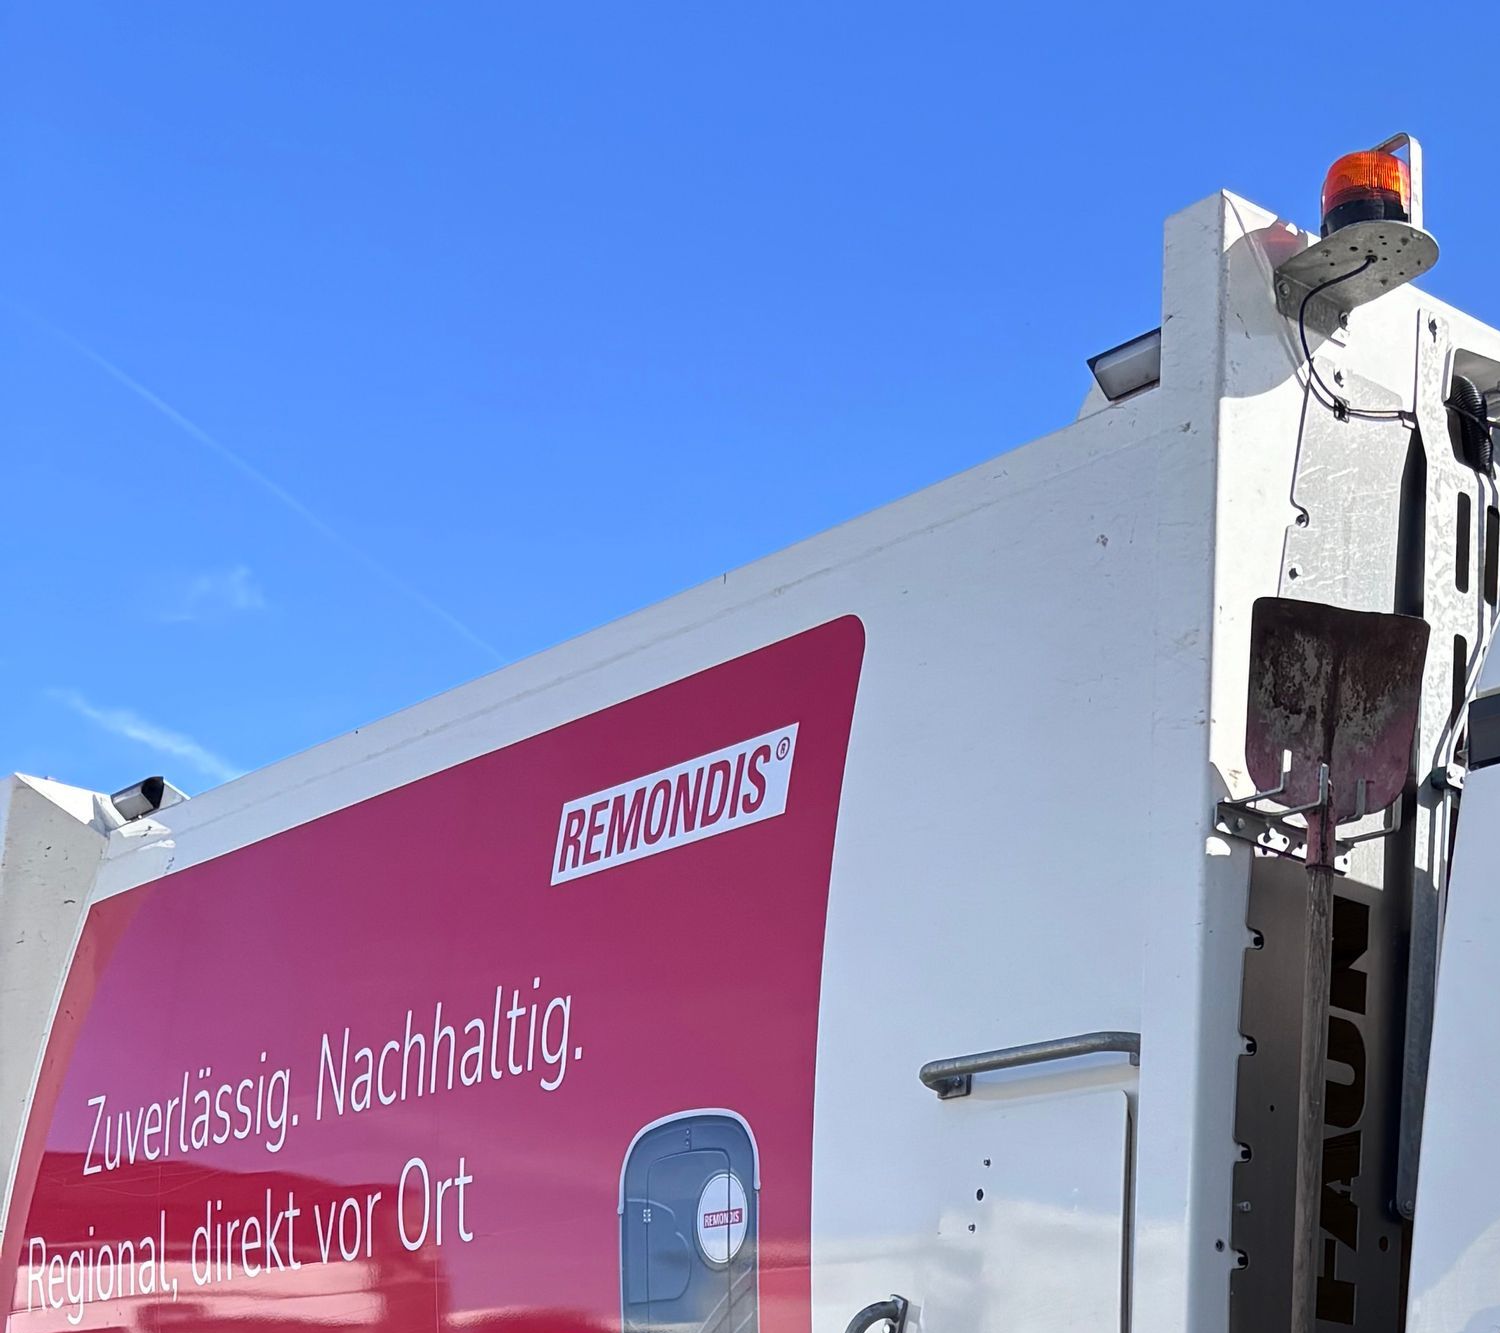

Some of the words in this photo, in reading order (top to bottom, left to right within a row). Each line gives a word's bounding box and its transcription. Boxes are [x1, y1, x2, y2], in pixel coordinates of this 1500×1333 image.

[82, 1051, 299, 1177] Zuverlässig.
[315, 976, 584, 1121] Nachhaltig.
[27, 1208, 180, 1327] Regional,
[192, 1187, 302, 1285] direkt
[314, 1186, 383, 1265] vor
[397, 1156, 475, 1253] Ort
